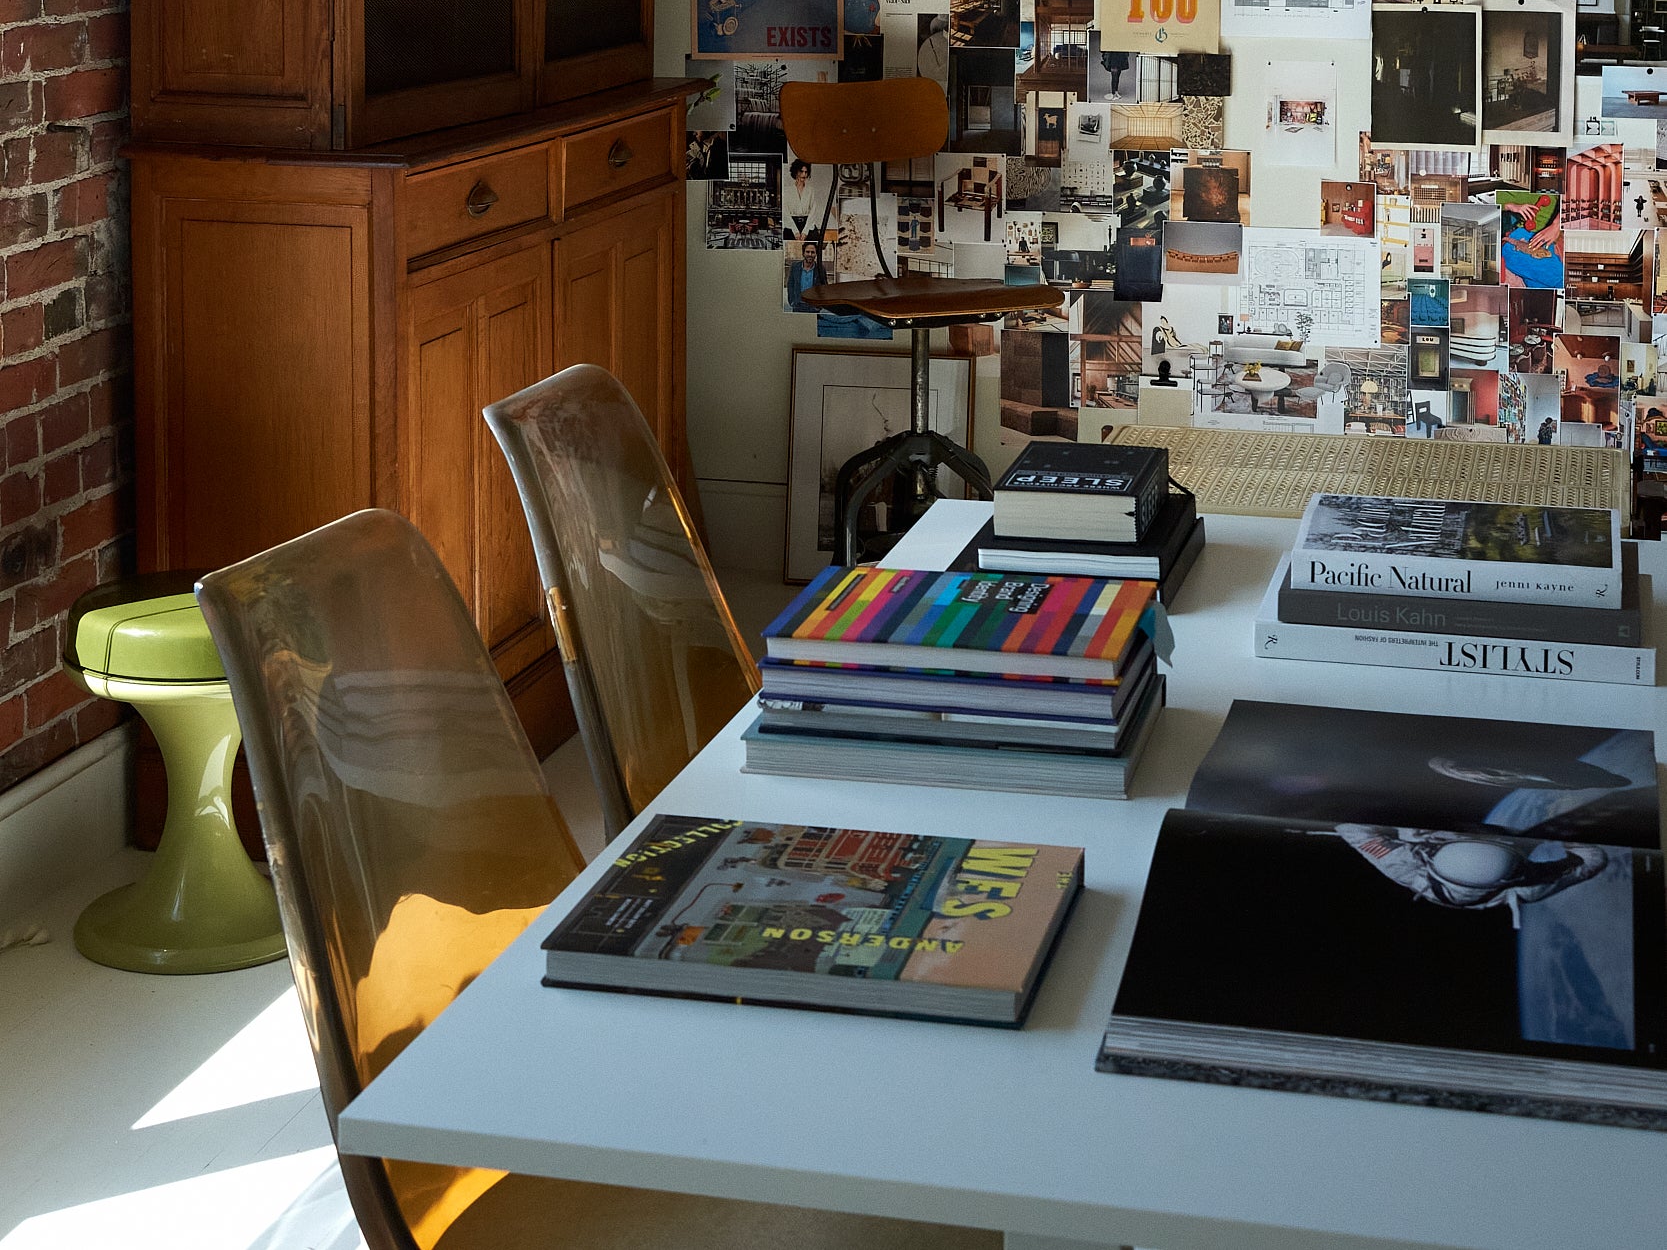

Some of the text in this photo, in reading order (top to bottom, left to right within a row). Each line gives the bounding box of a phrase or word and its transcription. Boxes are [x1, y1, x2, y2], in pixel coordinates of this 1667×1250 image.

[766, 26, 832, 48] EXISTS
[1016, 475, 1125, 486] SLEEP
[1310, 560, 1472, 595] Pacific Natural
[1337, 603, 1446, 627] Louis Kahn
[1354, 634, 1378, 643] FASHION
[1388, 638, 1427, 646] INTERPRETERS
[1440, 641, 1574, 676] STYLIST
[939, 848, 1039, 921] WES
[761, 926, 964, 955] ANDERSON
